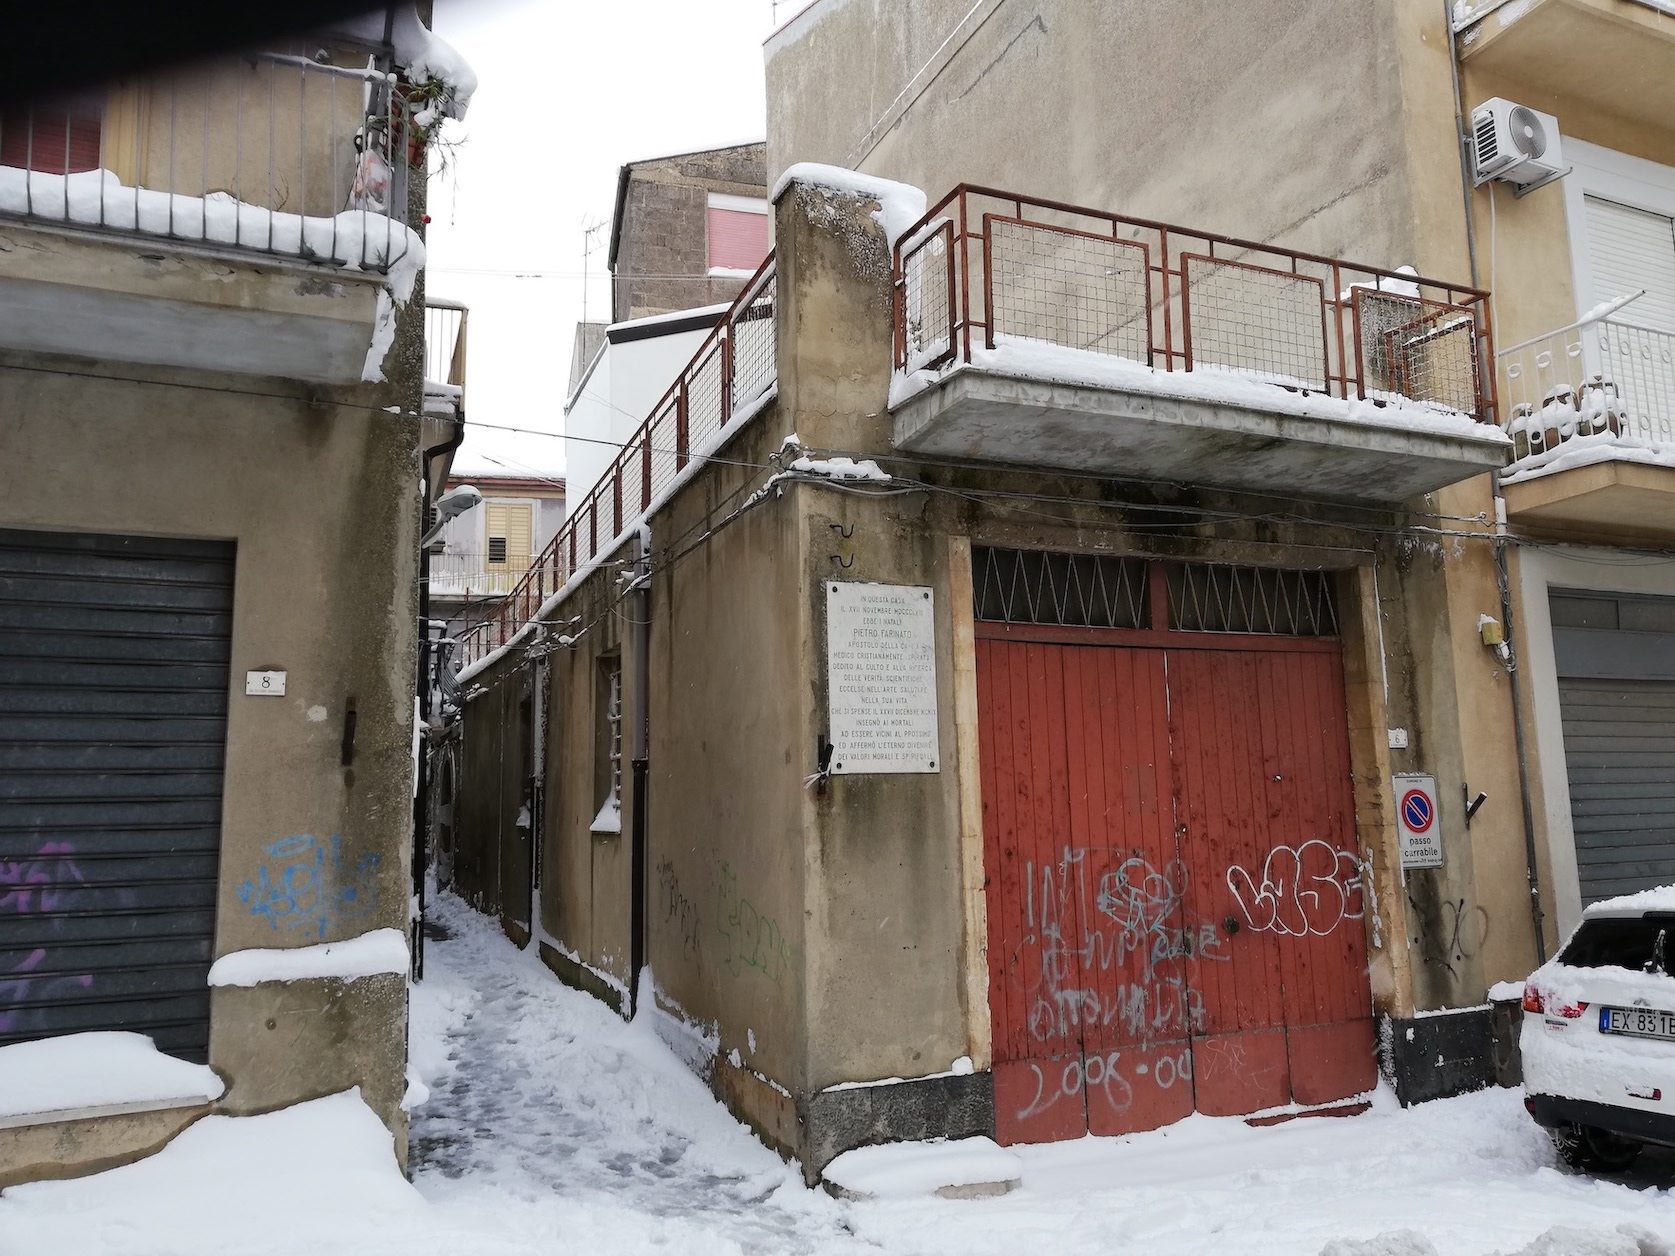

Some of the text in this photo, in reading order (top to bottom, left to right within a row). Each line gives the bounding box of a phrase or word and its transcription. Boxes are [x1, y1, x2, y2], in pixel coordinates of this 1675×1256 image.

[853, 628, 912, 638] PIETRO FARINATO
[262, 676, 270, 688] 8
[1395, 734, 1400, 744] 6
[1409, 837, 1431, 846] passo
[1404, 847, 1438, 857] carrabile
[1612, 1012, 1630, 1030] EX
